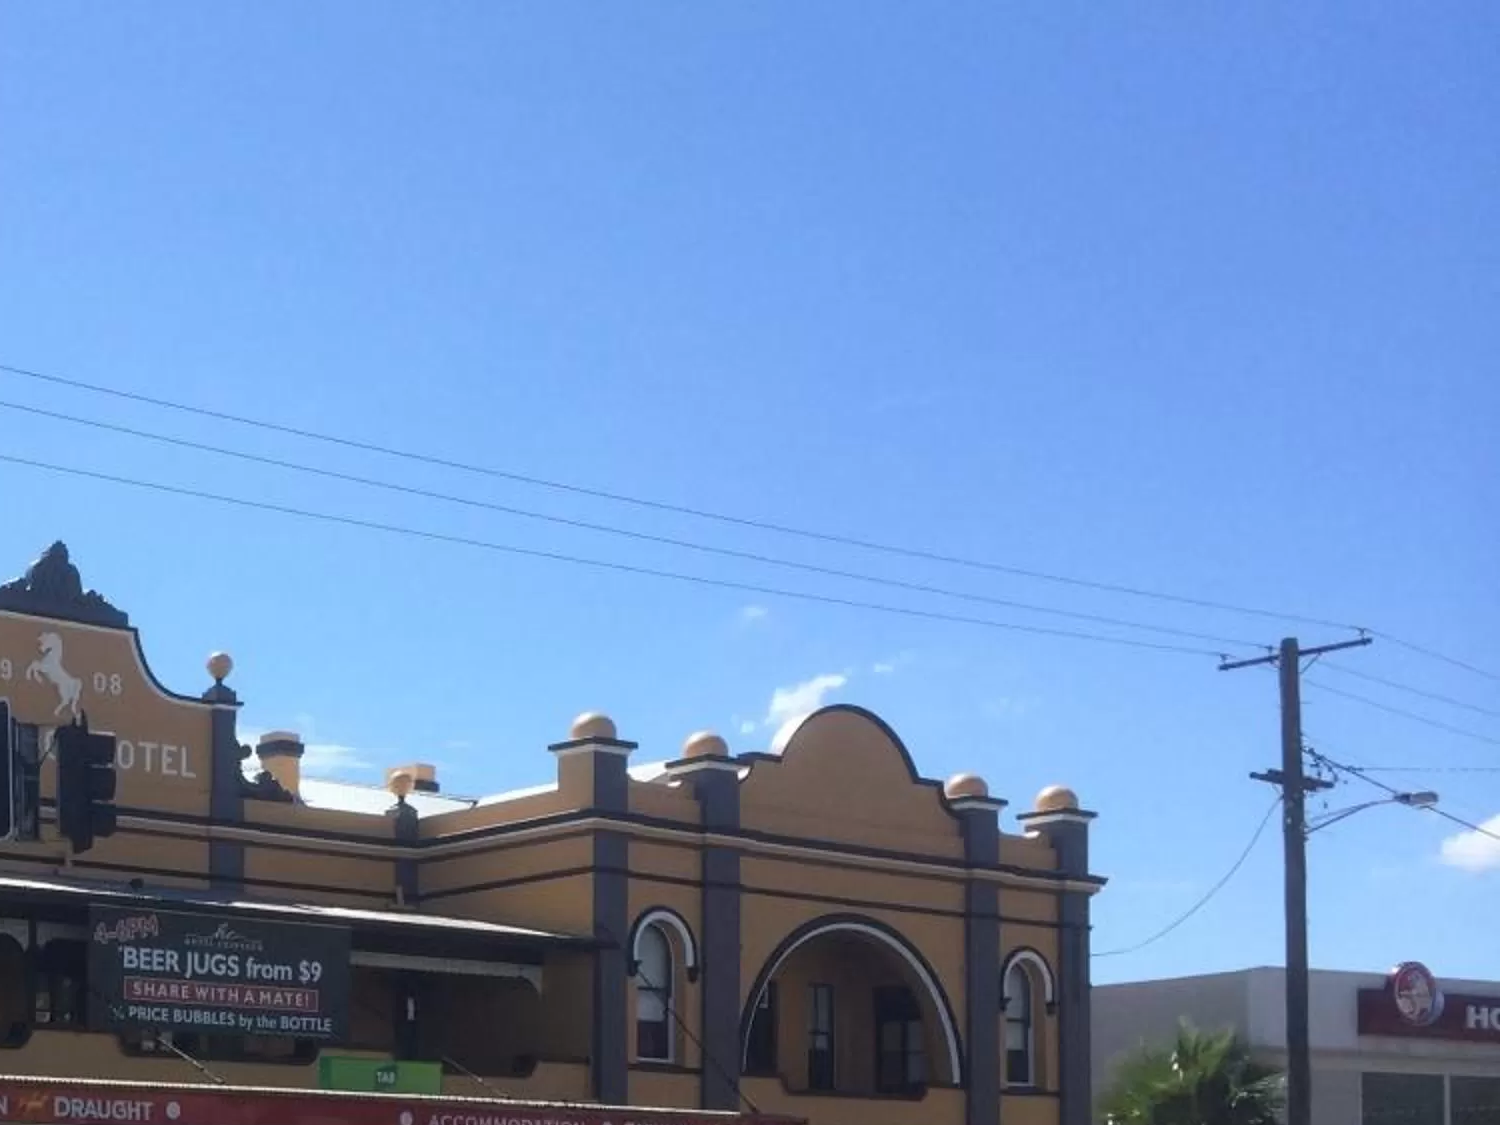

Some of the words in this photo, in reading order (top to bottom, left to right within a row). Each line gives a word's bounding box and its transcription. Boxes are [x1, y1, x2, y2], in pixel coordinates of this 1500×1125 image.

[93, 671, 122, 696] 08
[116, 737, 197, 780] OTEL
[186, 951, 240, 979] JUGS
[246, 956, 292, 982] from
[298, 959, 323, 984] $9
[132, 980, 191, 1000] SHARE
[194, 984, 239, 1003] WITH
[244, 990, 254, 1005] A
[258, 990, 311, 1009] MATE!
[127, 1004, 169, 1022] PRICE
[172, 1007, 236, 1027] BUBBLES
[239, 1013, 254, 1030] by
[256, 1013, 278, 1030] the
[280, 1015, 333, 1033] BOTTLE
[53, 1095, 154, 1121] DRAUGHT
